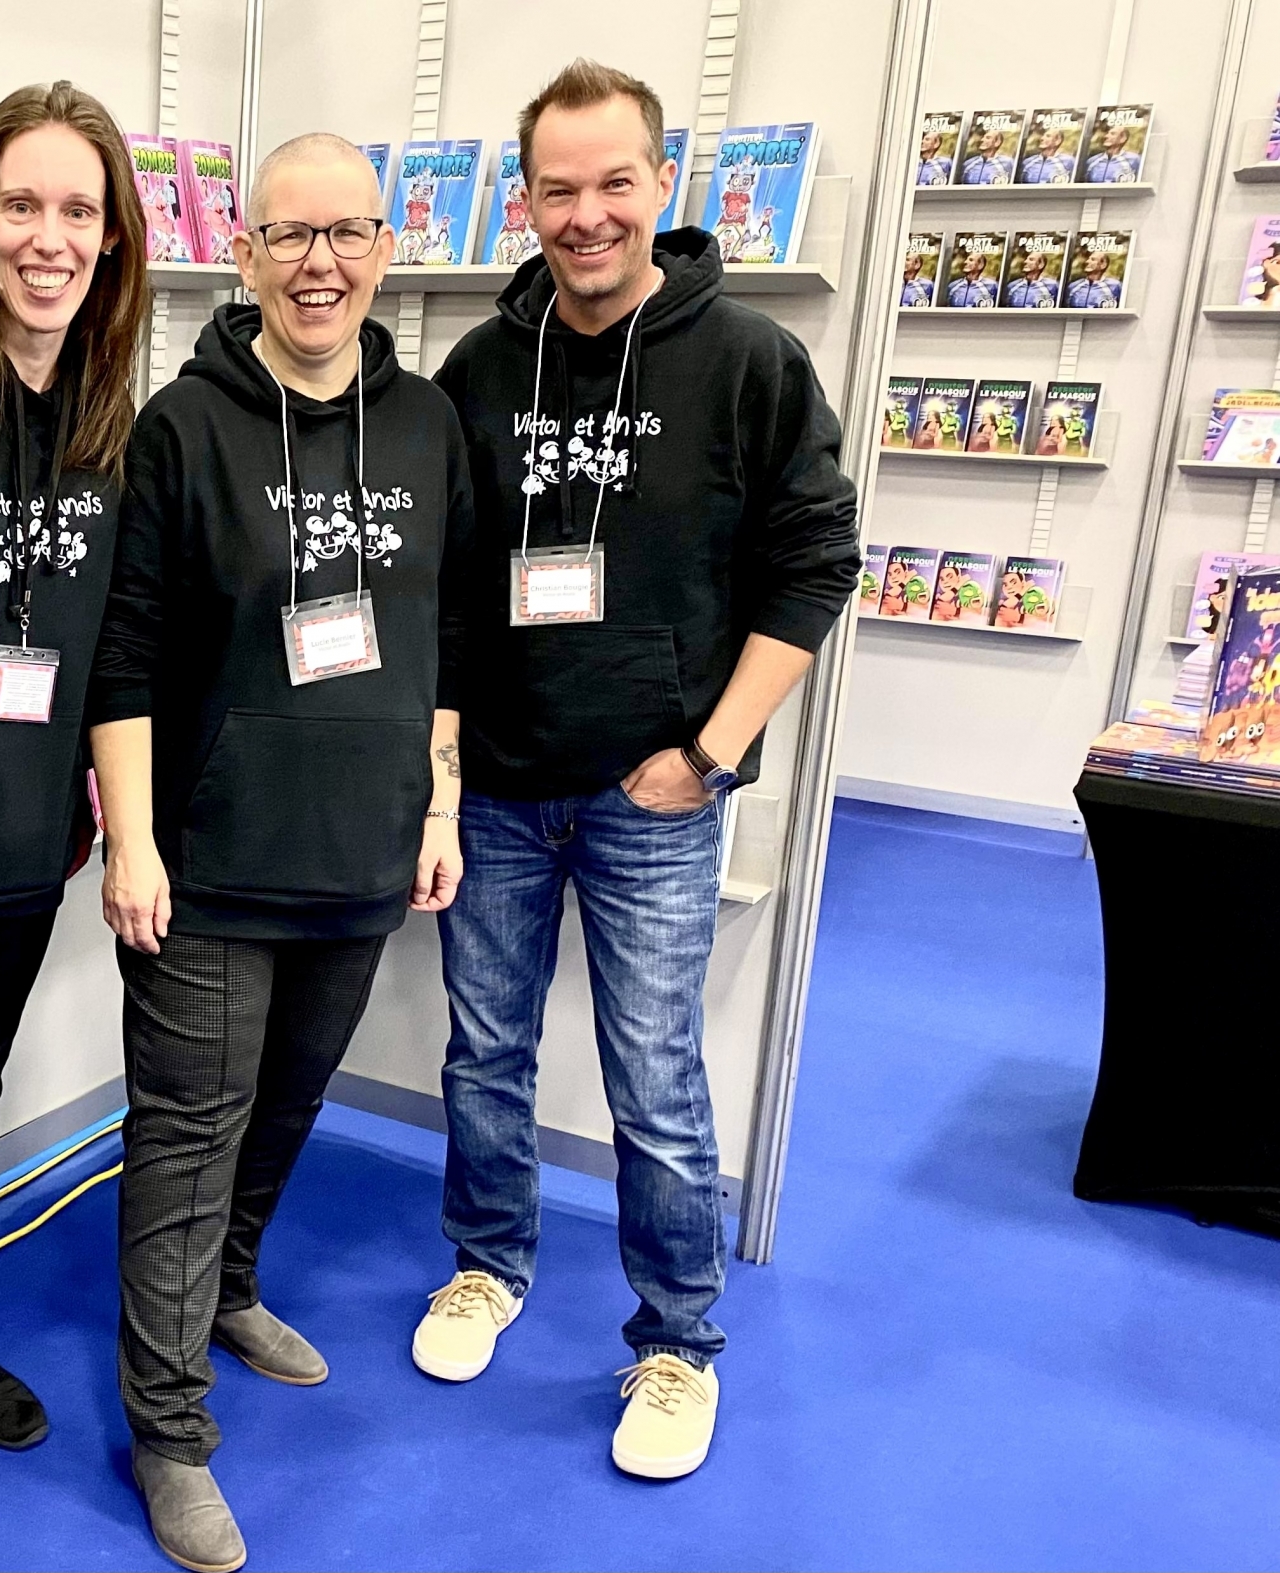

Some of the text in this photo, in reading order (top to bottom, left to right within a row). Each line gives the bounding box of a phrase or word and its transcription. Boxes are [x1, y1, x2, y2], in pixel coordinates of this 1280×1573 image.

[720, 139, 801, 168] ZOMBIE
[133, 149, 177, 174] ZOMBIE
[194, 154, 233, 180] ZOMBIE
[403, 155, 472, 178] ZOMBIE
[936, 388, 969, 396] MASQUE
[991, 390, 1026, 399] MASQUE
[1060, 392, 1096, 400] MASQUE
[514, 411, 561, 437] Victor
[574, 413, 595, 437] et
[265, 485, 414, 511] Victor et Anaïs
[867, 553, 885, 561] QUE
[903, 557, 935, 566] MASQUE
[956, 562, 988, 570] MASQUE
[1019, 567, 1054, 576] MASQUE
[530, 583, 589, 592] Christian Bougie
[310, 634, 356, 648] Lucie Bernier
